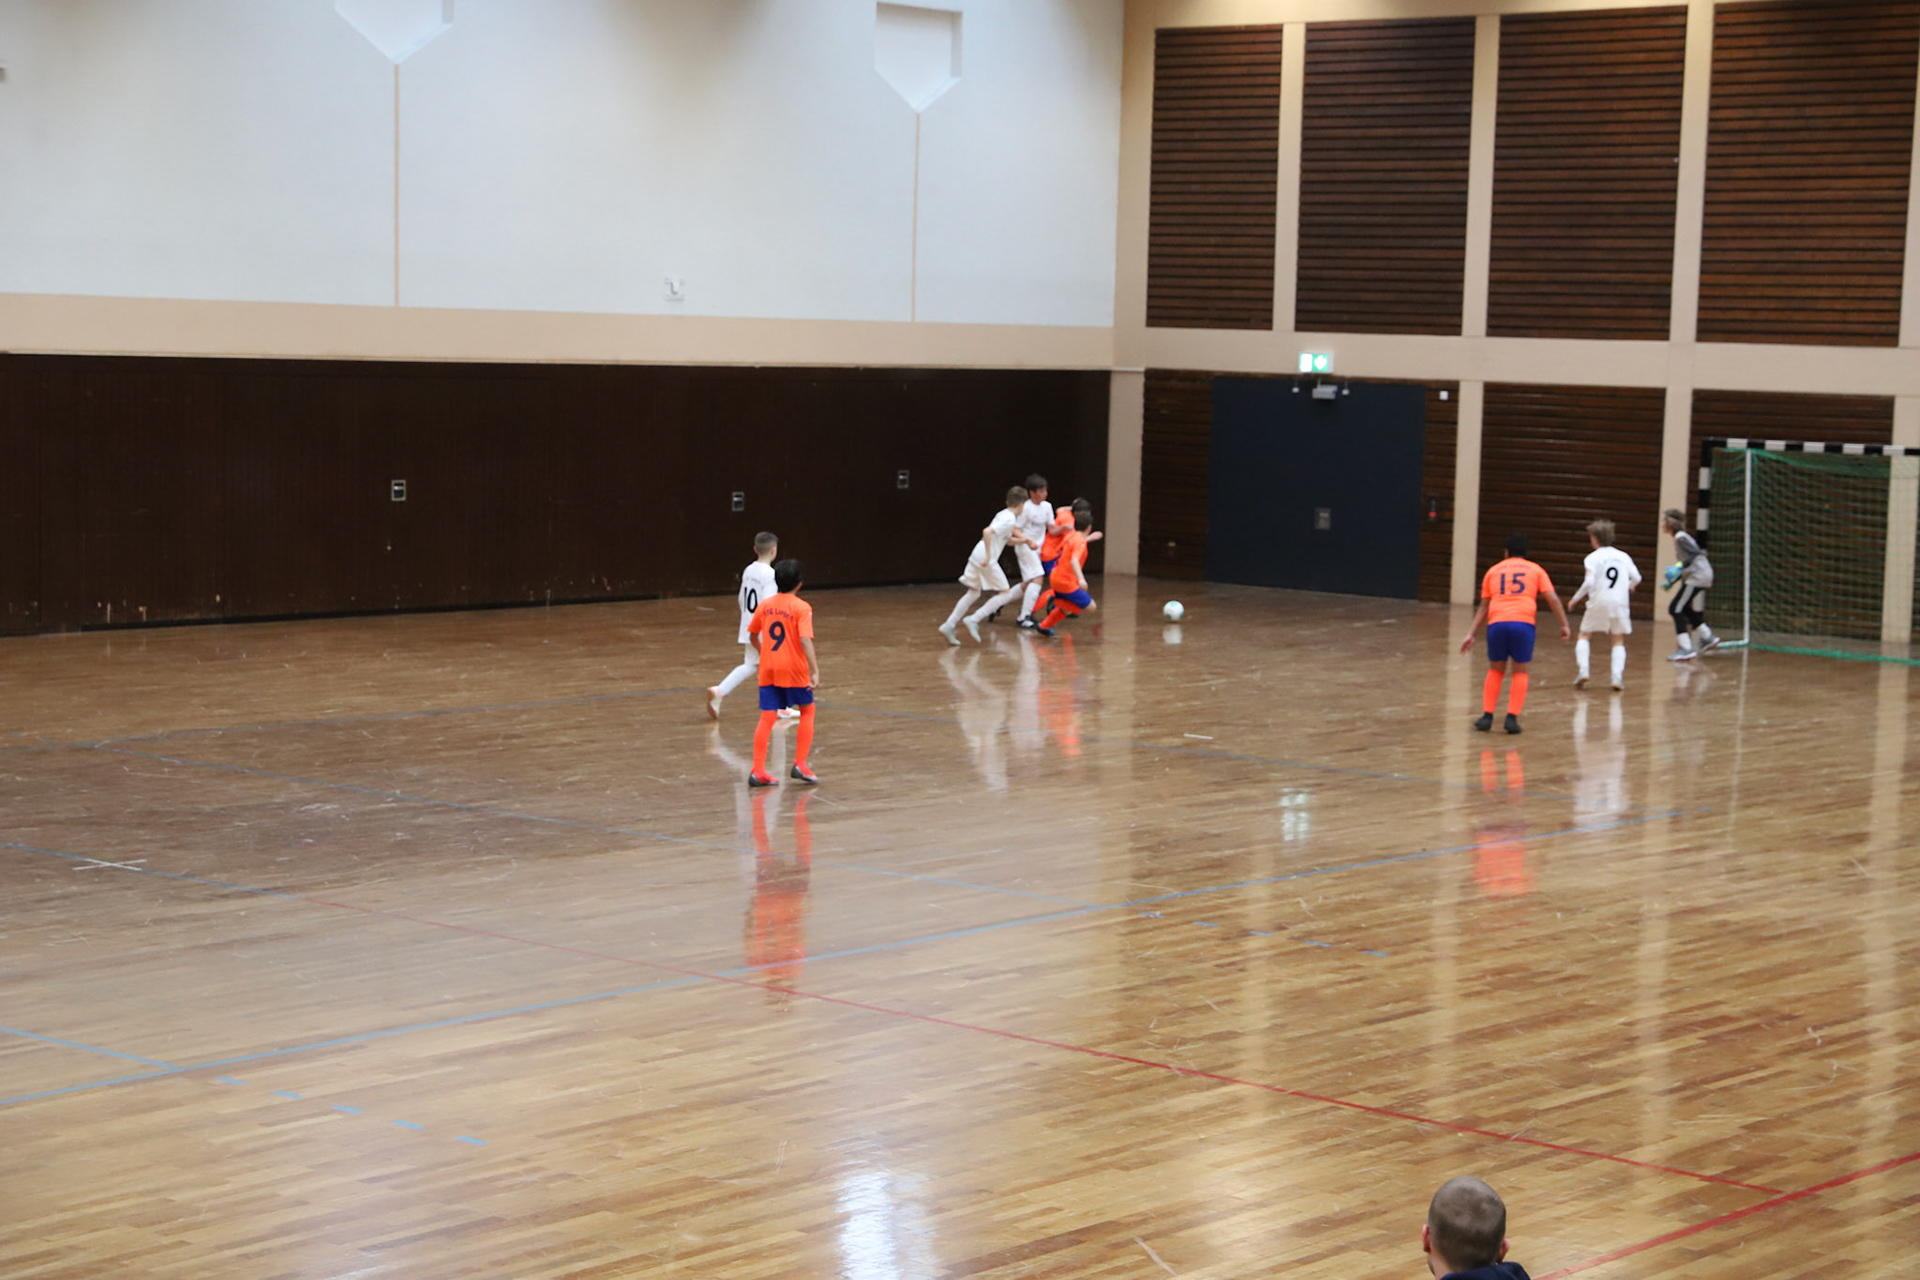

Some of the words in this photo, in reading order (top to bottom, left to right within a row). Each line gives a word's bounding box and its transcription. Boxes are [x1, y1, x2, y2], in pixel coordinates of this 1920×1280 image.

[1500, 573, 1526, 595] 15
[1606, 566, 1619, 589] 9
[744, 586, 758, 613] 10
[769, 621, 786, 652] 9
